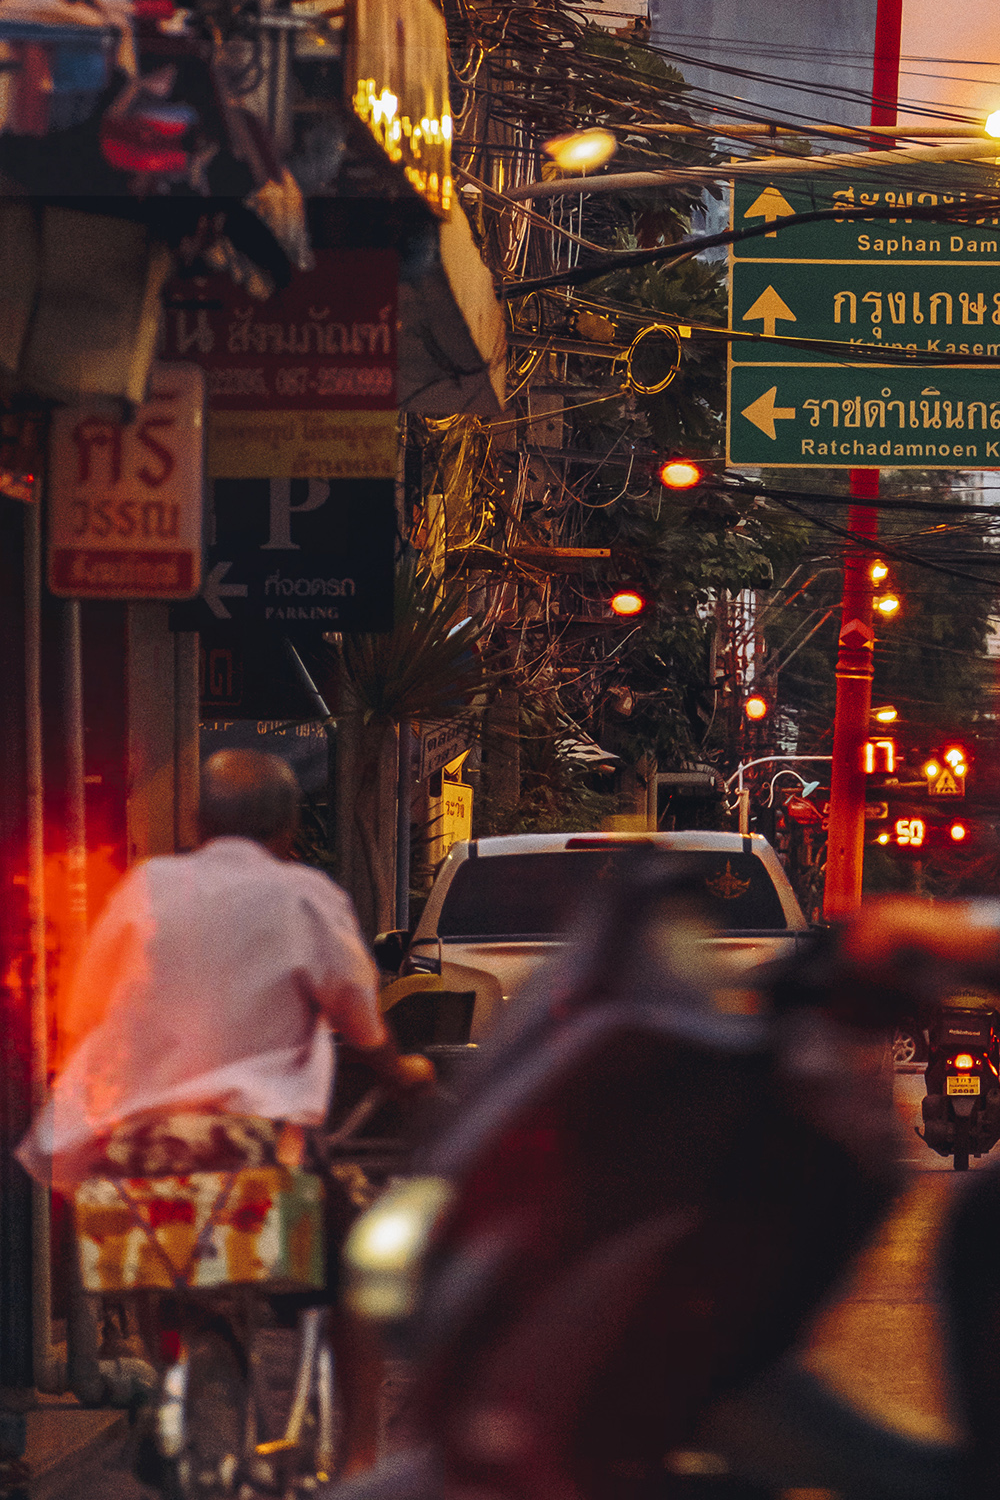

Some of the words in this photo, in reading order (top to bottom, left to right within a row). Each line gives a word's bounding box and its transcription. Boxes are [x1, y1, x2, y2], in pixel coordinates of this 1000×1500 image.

[857, 234, 941, 256] Saphan
[950, 235, 998, 253] Dam
[801, 438, 978, 458] Ratchadamnoen
[264, 606, 340, 621] PARKING
[896, 819, 925, 847] 50
